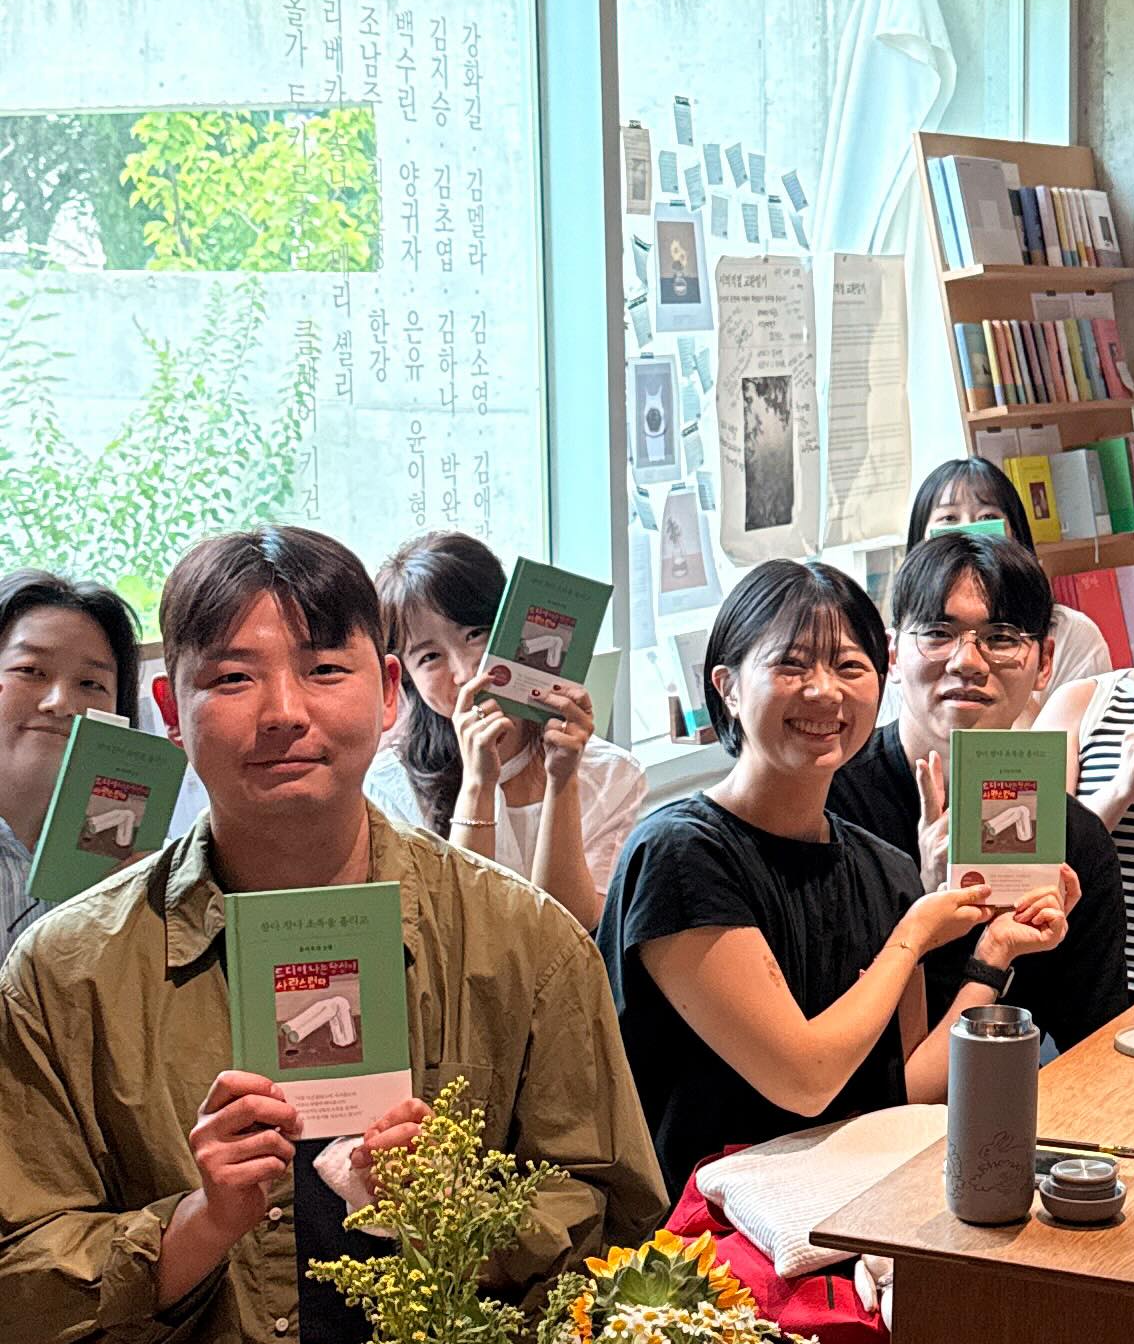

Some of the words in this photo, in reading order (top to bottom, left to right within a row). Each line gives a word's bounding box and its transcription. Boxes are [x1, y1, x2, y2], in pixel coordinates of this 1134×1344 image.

[395, 10, 416, 122] 백수린
[430, 16, 450, 127] 김지승
[463, 22, 482, 130] 강화길
[399, 161, 422, 272] 양귀자
[434, 165, 455, 273] 김초엽
[467, 168, 488, 275] 김멜라
[369, 309, 390, 382] 한강
[403, 310, 424, 381] 은유
[438, 310, 459, 417] 김하나
[471, 310, 489, 416] 김소영
[300, 445, 320, 520] 키건
[406, 420, 426, 526] 윤이형
[440, 452, 461, 529] 박완
